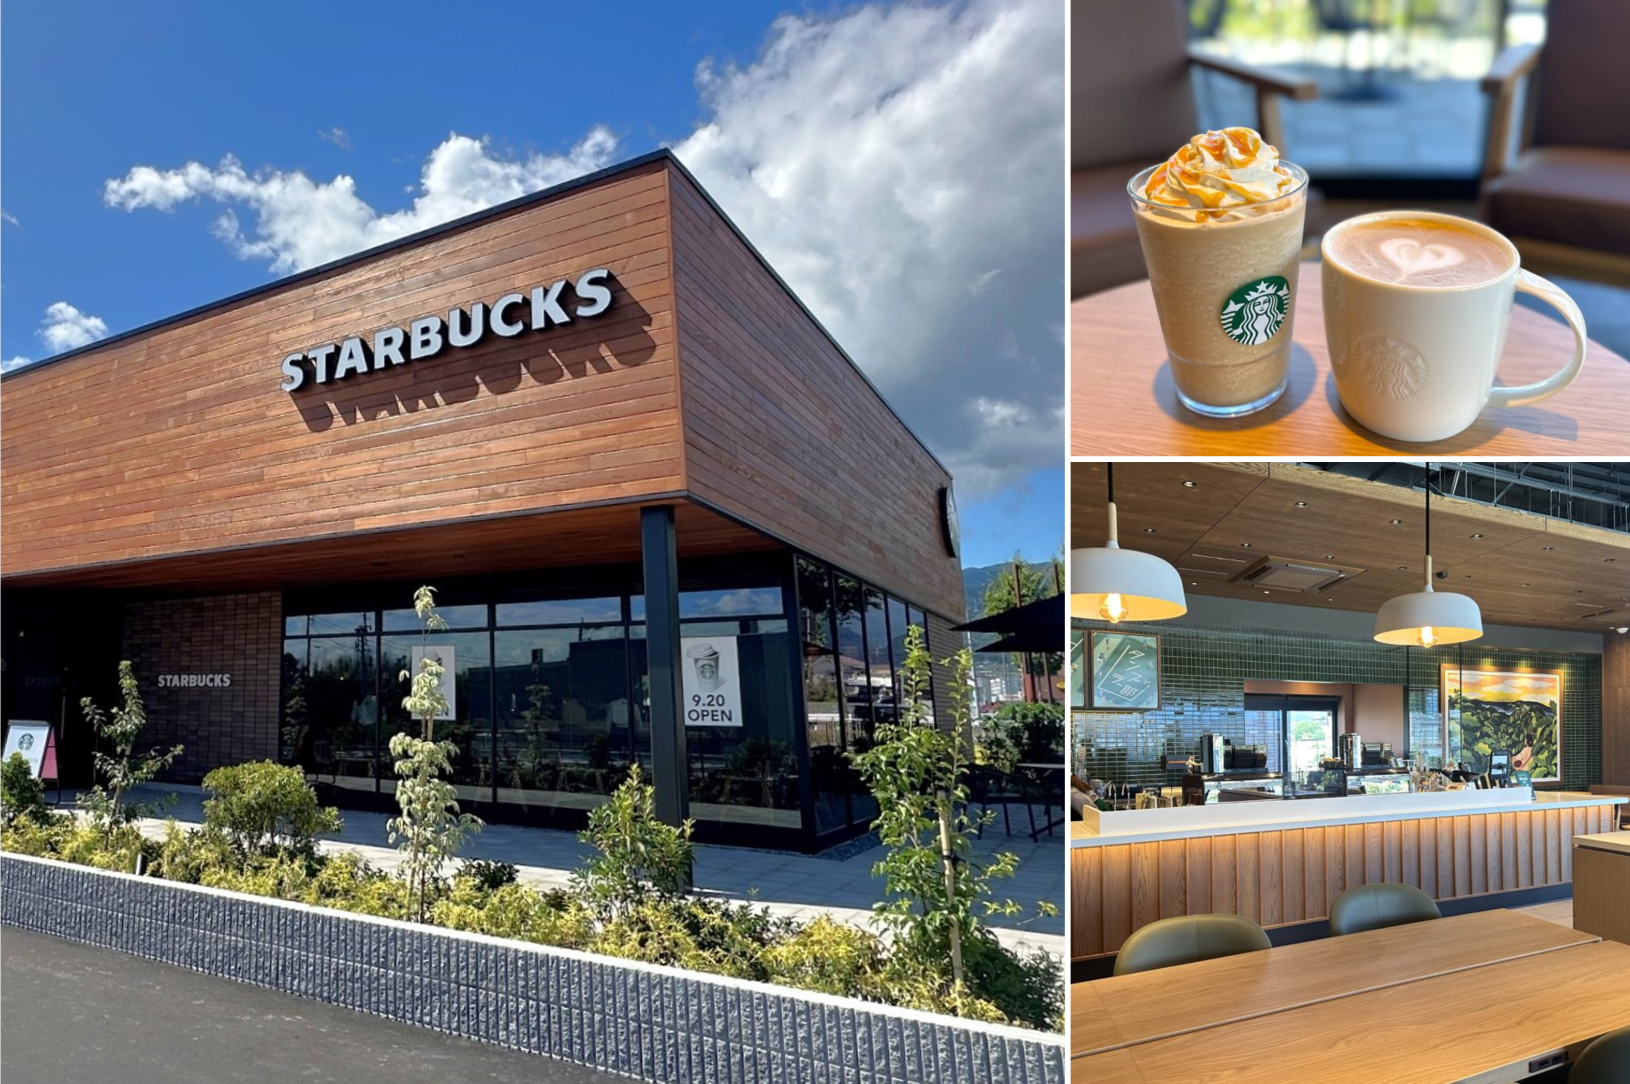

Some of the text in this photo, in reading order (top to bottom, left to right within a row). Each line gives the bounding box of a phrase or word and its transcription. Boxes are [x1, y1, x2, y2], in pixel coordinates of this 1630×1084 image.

[280, 268, 615, 392] STARBUCKS
[157, 673, 231, 687] STARBUCKS
[692, 694, 725, 707] 9.20
[688, 709, 732, 722] OPEN
